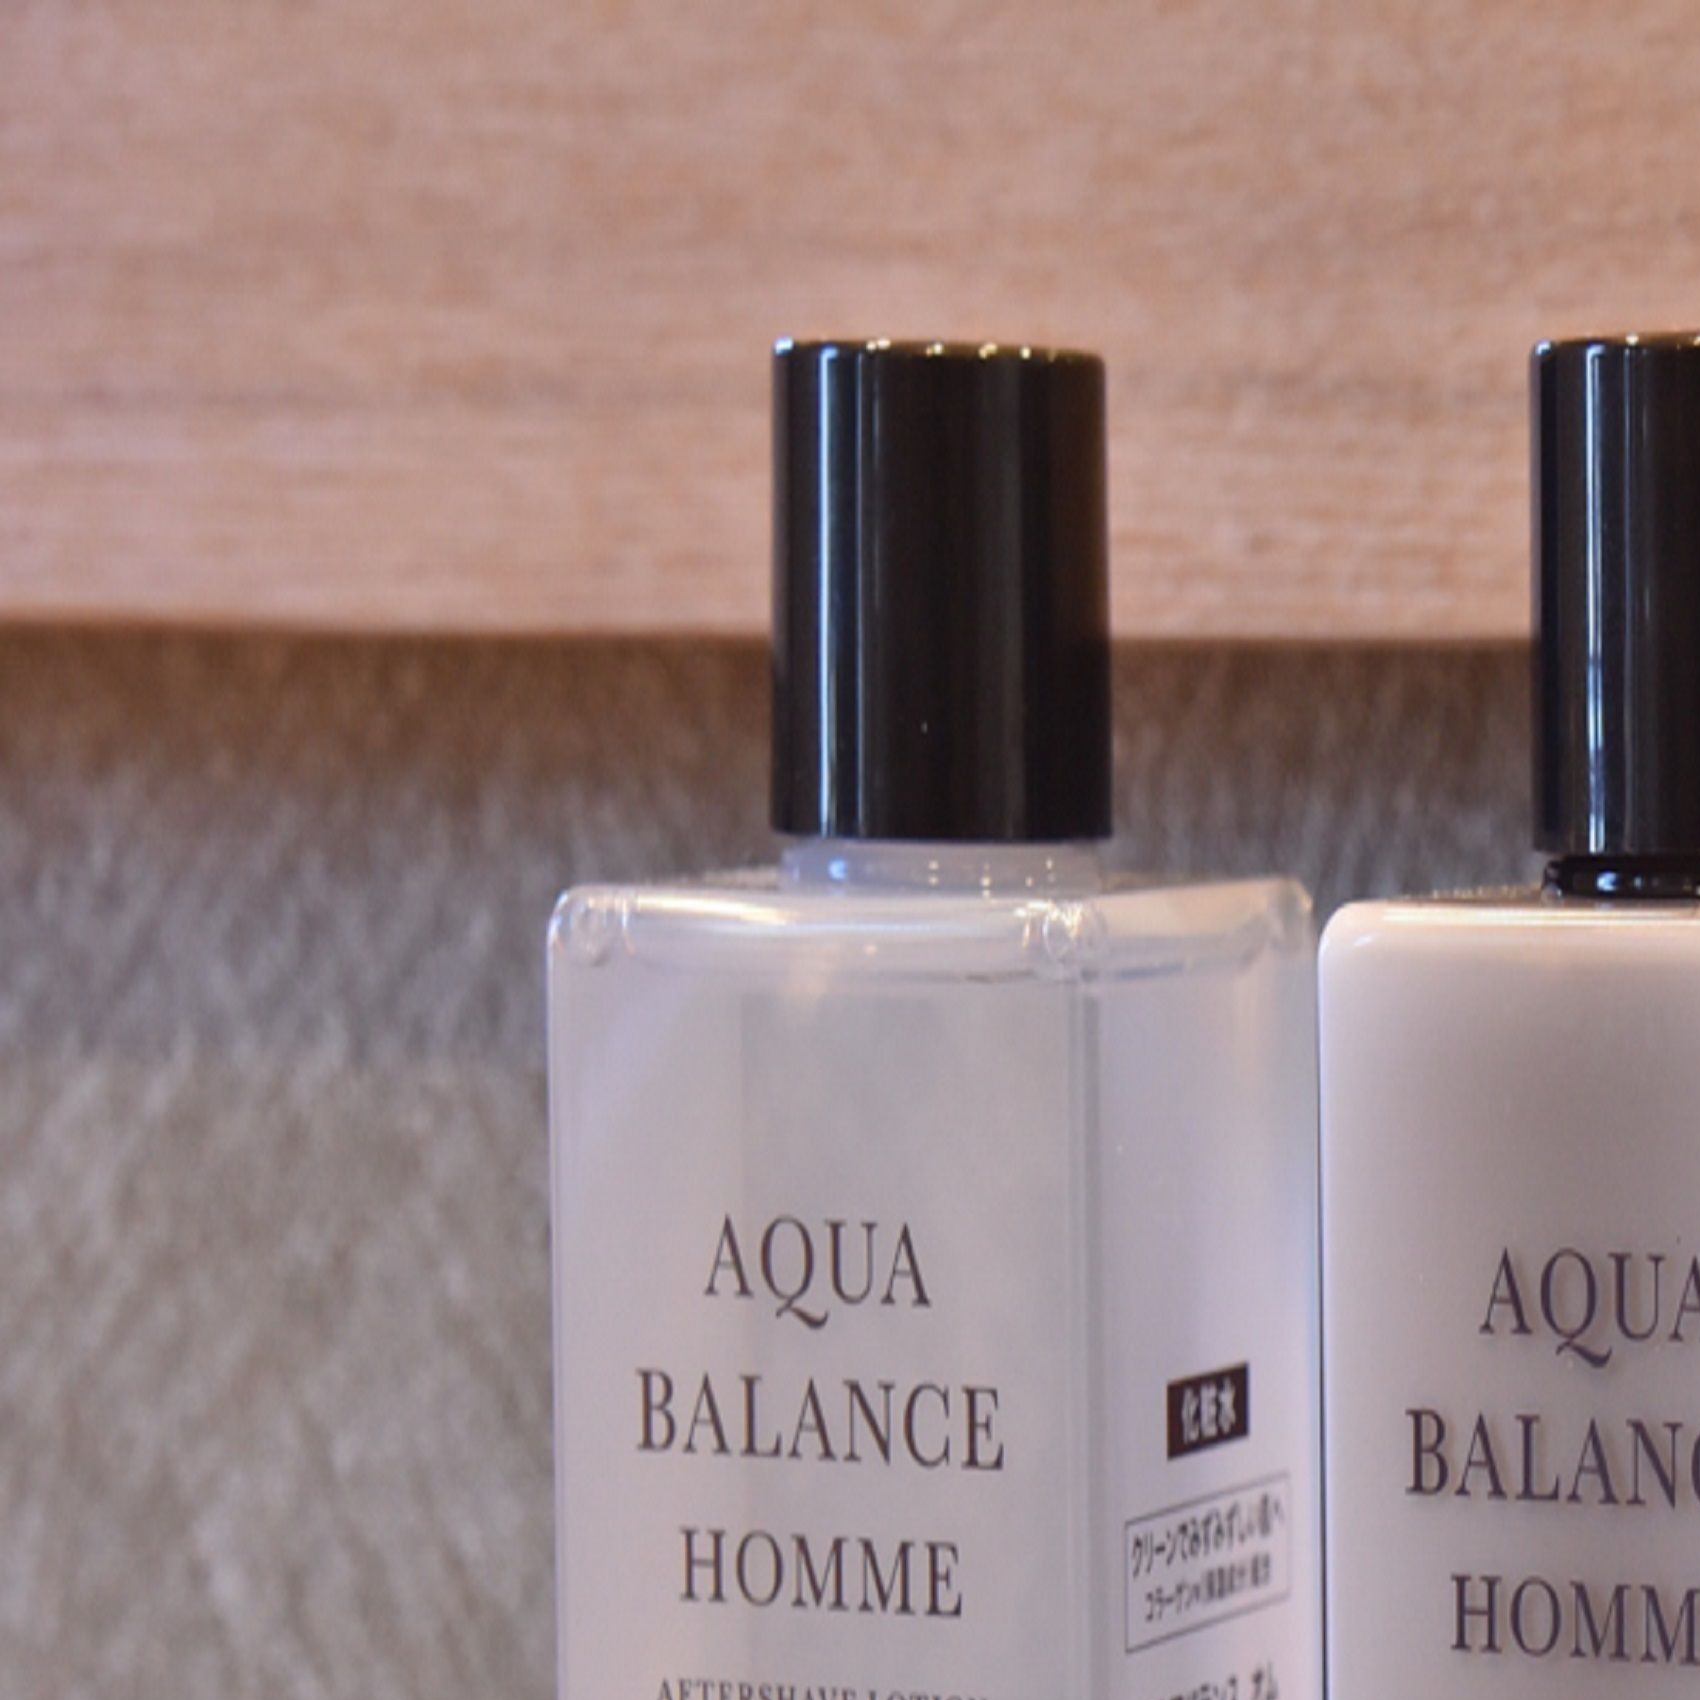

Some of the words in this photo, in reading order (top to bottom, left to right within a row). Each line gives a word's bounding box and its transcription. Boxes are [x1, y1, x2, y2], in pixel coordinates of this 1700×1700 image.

[704, 1214, 931, 1330] AQUA
[636, 1368, 1004, 1471] BALANCE
[680, 1526, 963, 1618] HOMME
